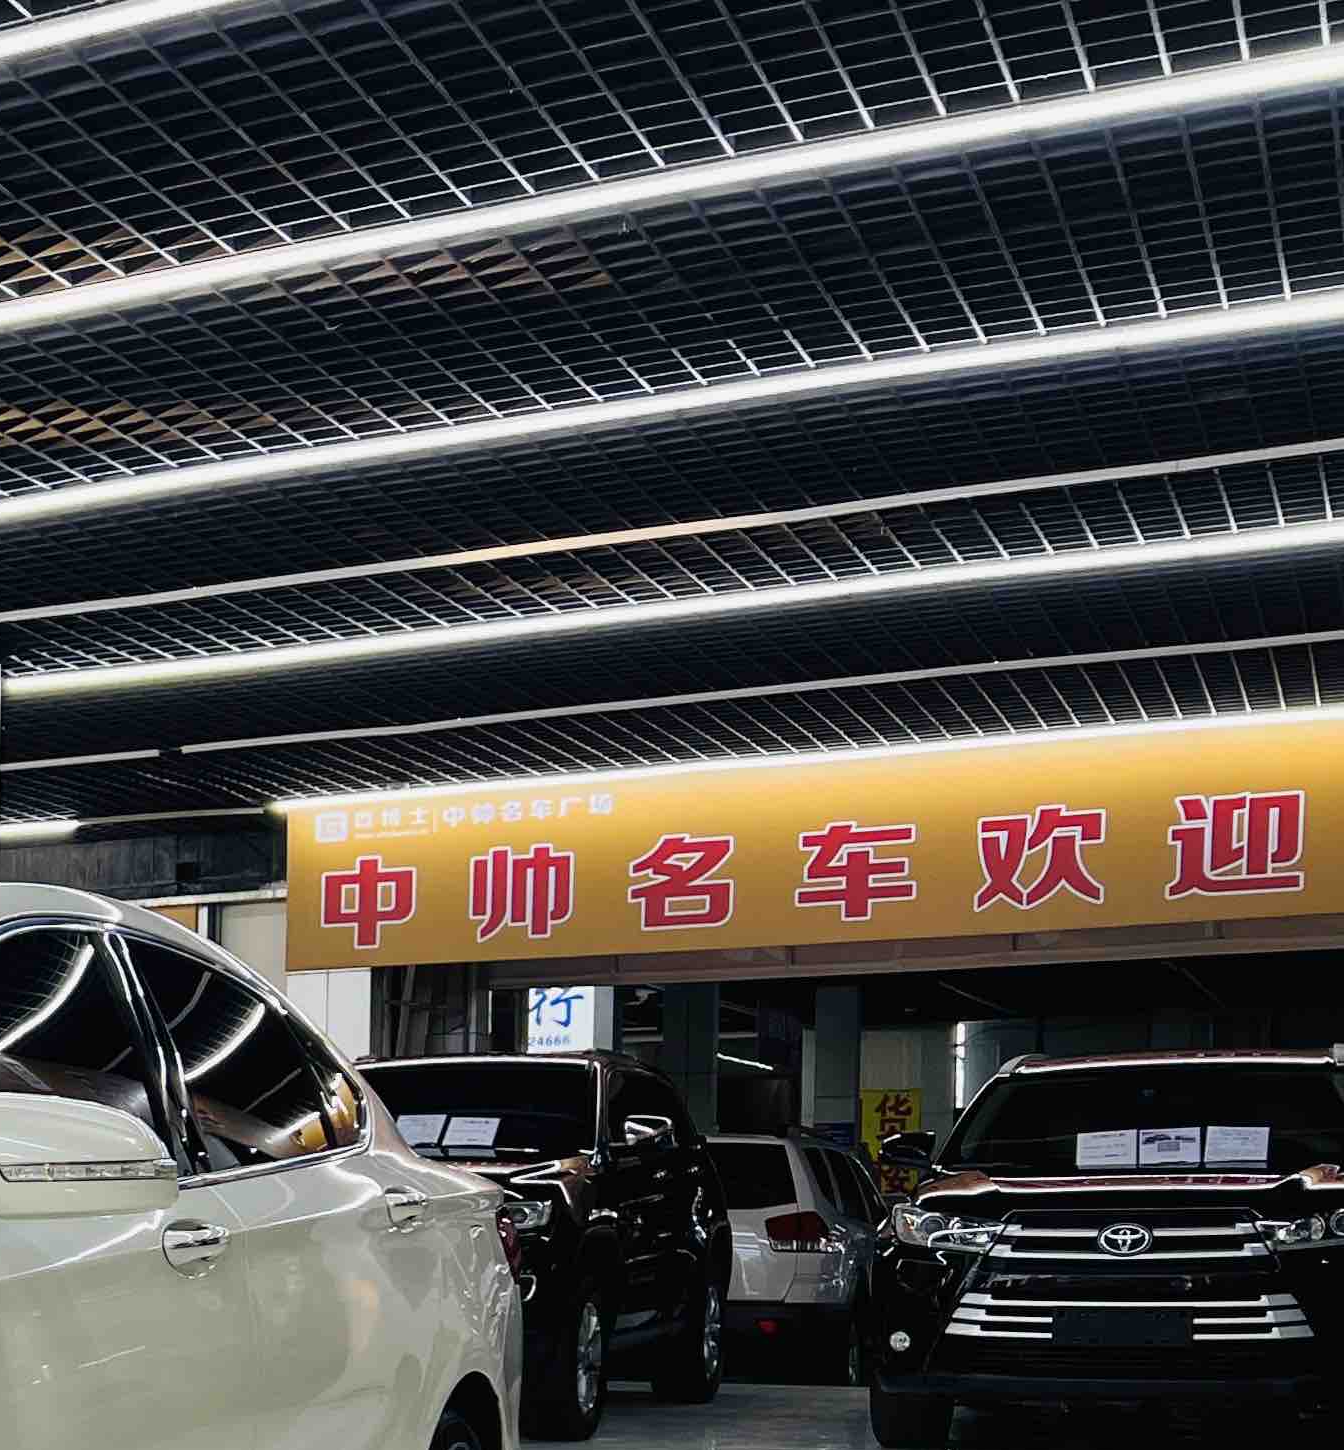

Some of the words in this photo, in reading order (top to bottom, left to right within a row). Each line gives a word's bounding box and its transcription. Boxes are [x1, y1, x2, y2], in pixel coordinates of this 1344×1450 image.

[321, 790, 1304, 949] 中帅名车欢迎
